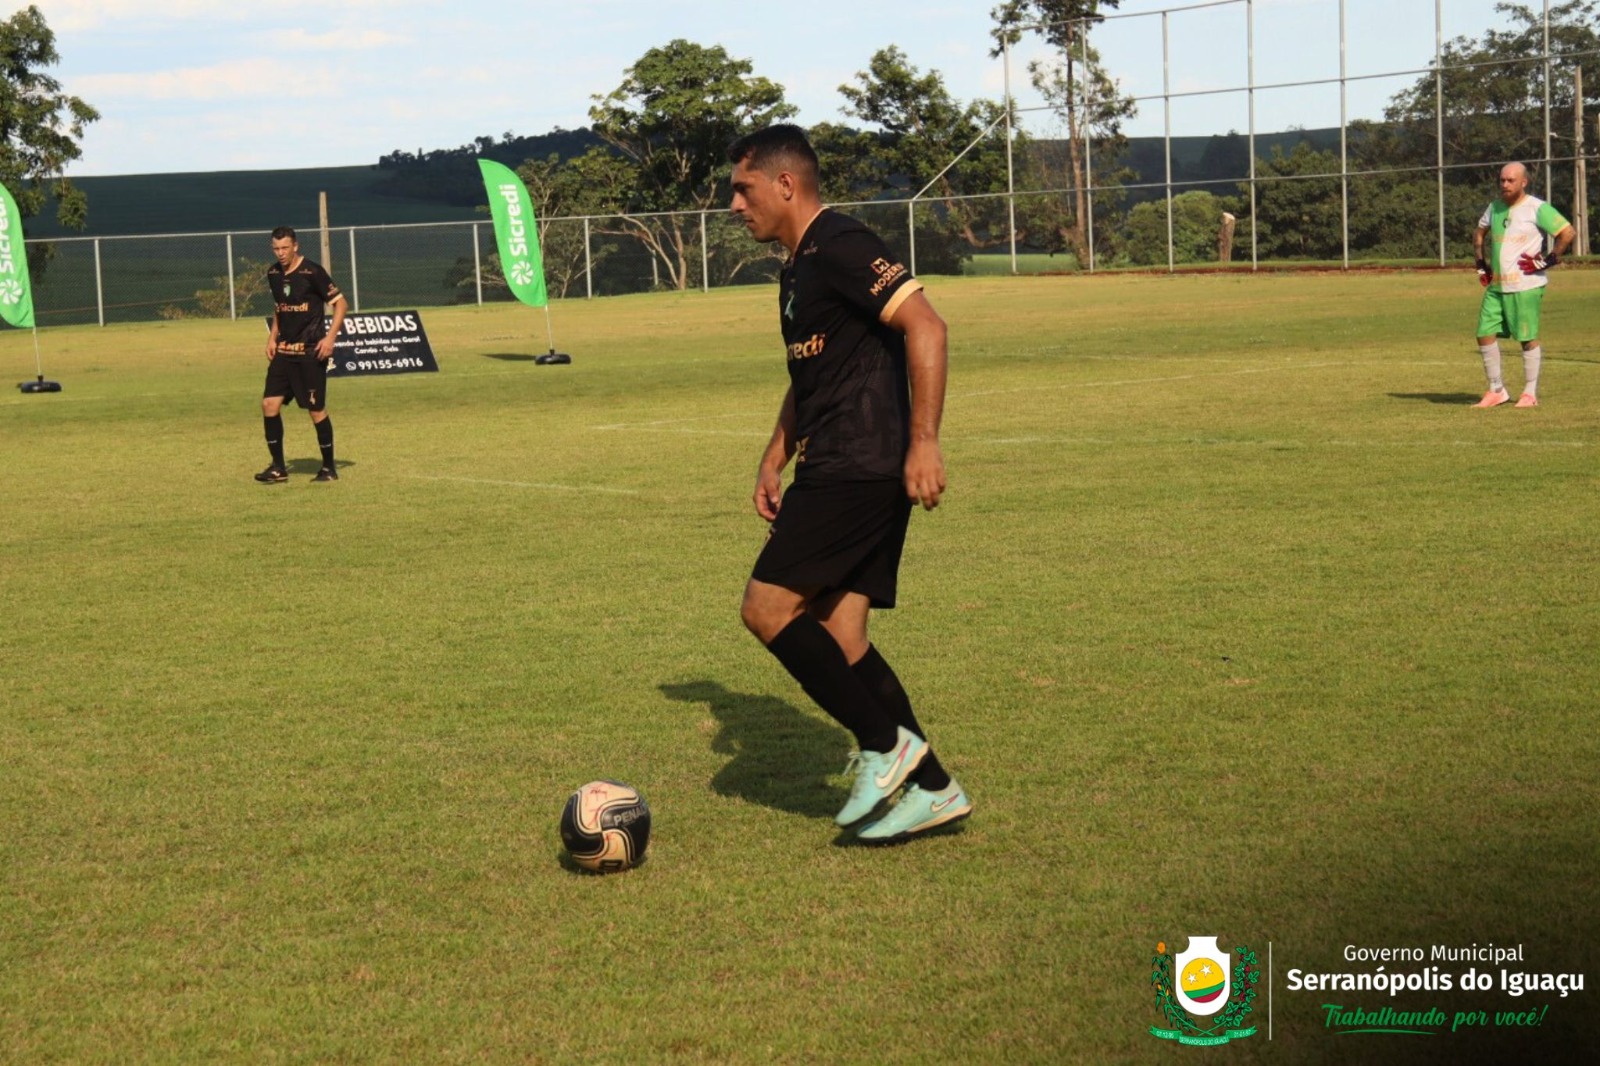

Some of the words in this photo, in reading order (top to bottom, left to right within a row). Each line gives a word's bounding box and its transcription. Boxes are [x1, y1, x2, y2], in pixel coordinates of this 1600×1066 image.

[499, 184, 528, 256] Sicredi
[344, 314, 418, 335] BEBIDAS
[364, 337, 389, 346] bebidas
[358, 357, 423, 370] 99155-6916
